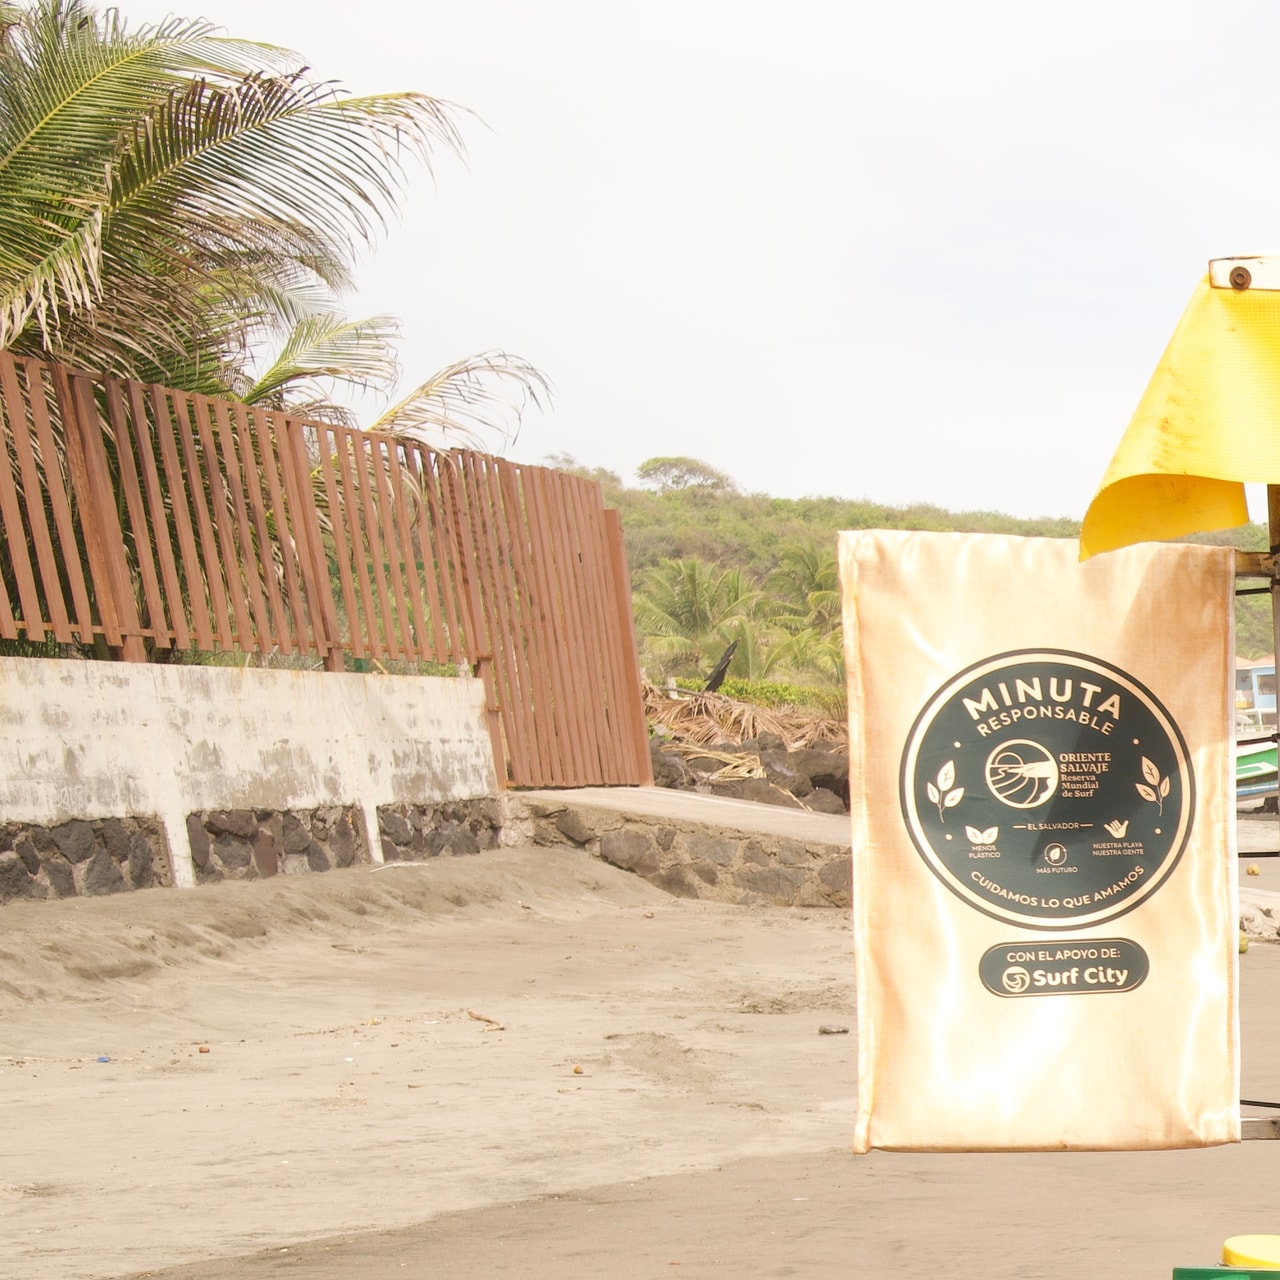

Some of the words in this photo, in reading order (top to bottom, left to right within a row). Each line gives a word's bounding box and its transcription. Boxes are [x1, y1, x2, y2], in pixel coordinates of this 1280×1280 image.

[962, 676, 1121, 721] MINUTA
[976, 705, 1114, 737] RESPONSABLE
[1059, 753, 1111, 763] ORIENTE
[1060, 763, 1109, 775] SALVAJE
[1061, 774, 1096, 782] Reserva
[1062, 782, 1099, 790] Mundial
[1062, 790, 1073, 798] de
[1074, 790, 1094, 798] Surf
[1027, 823, 1037, 831] EL
[1038, 822, 1081, 830] SALVADOR
[968, 851, 1001, 859] PLÁSTICO
[1123, 848, 1145, 856] GENTE
[1052, 866, 1078, 874] FUTURO
[971, 871, 1038, 907] CUIDAMOS
[1041, 898, 1060, 908] LO
[1063, 896, 1092, 909] QUE
[1094, 865, 1145, 902] AMAMOS
[1006, 951, 1036, 963] CON
[1038, 951, 1054, 961] EL
[1055, 949, 1099, 961] APOYO
[1101, 948, 1121, 959] DE:
[1033, 968, 1079, 987] Surf
[1083, 966, 1129, 986] City
